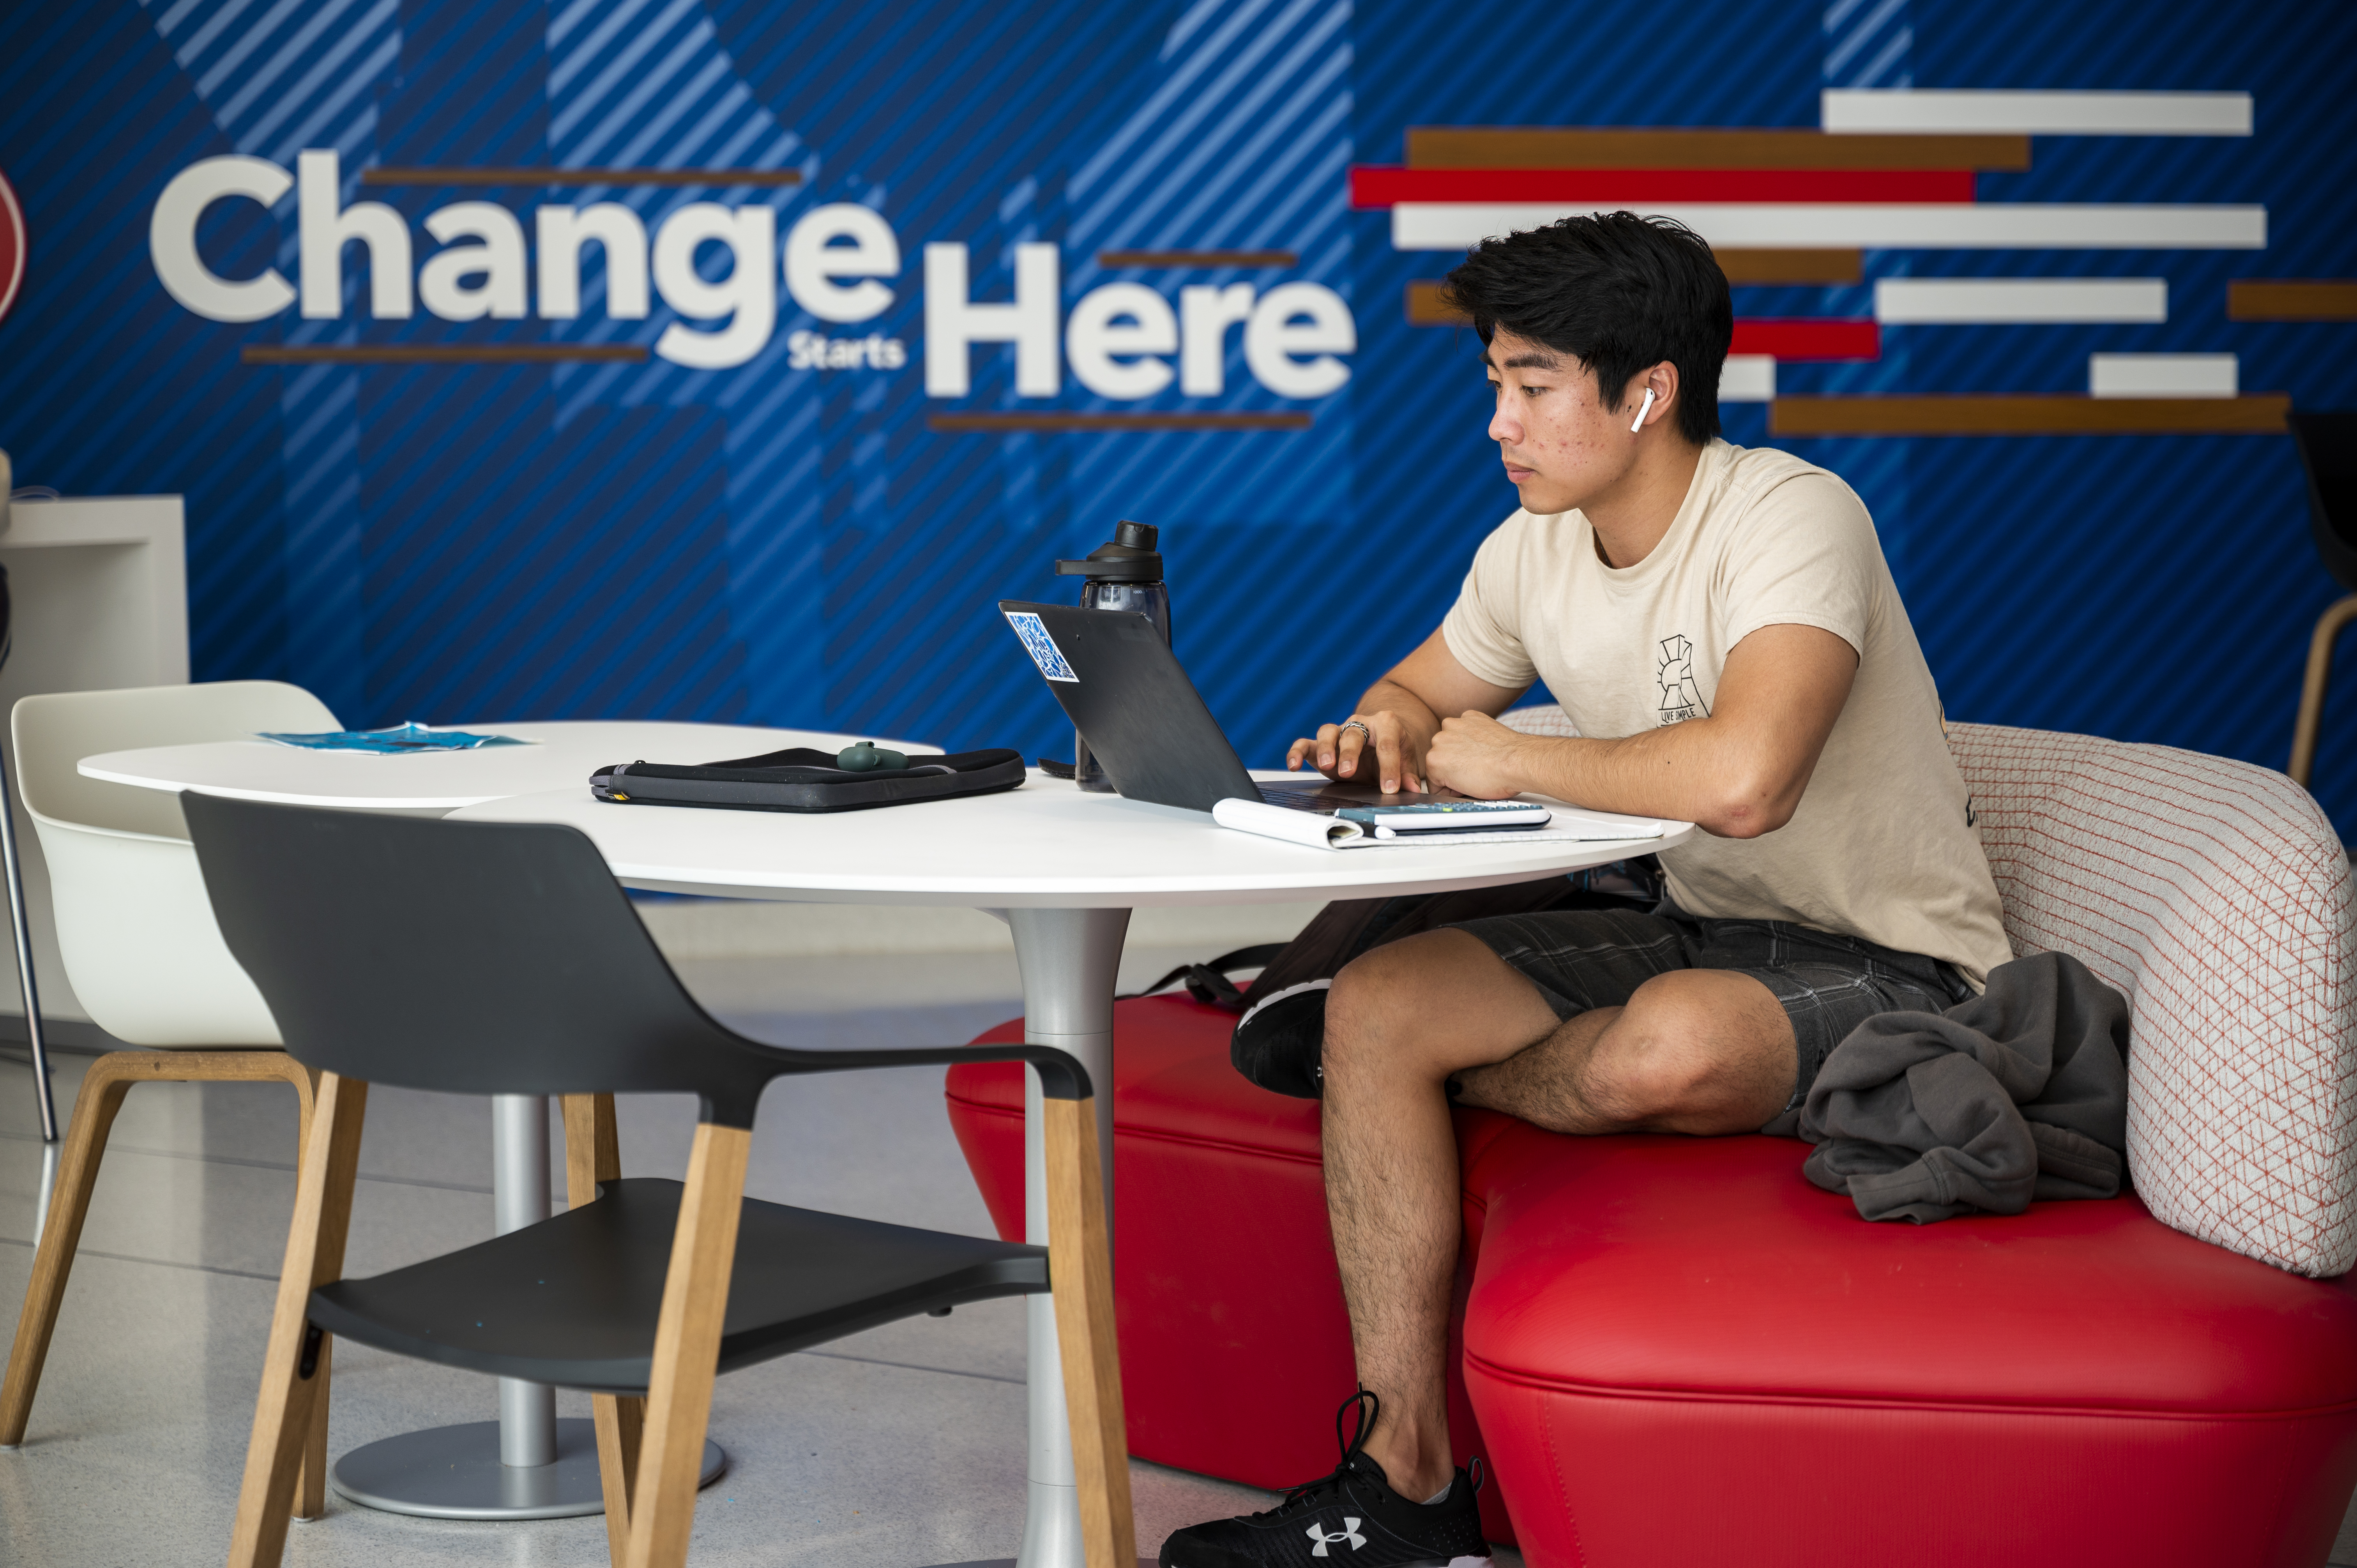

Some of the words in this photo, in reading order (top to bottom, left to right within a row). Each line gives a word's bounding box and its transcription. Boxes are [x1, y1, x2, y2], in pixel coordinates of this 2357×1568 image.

[149, 149, 901, 369] Change
[788, 330, 906, 369] Starts
[924, 242, 1356, 399] Here
[1661, 711, 1673, 723] LIVE
[1676, 708, 1696, 721] SIMPLE
